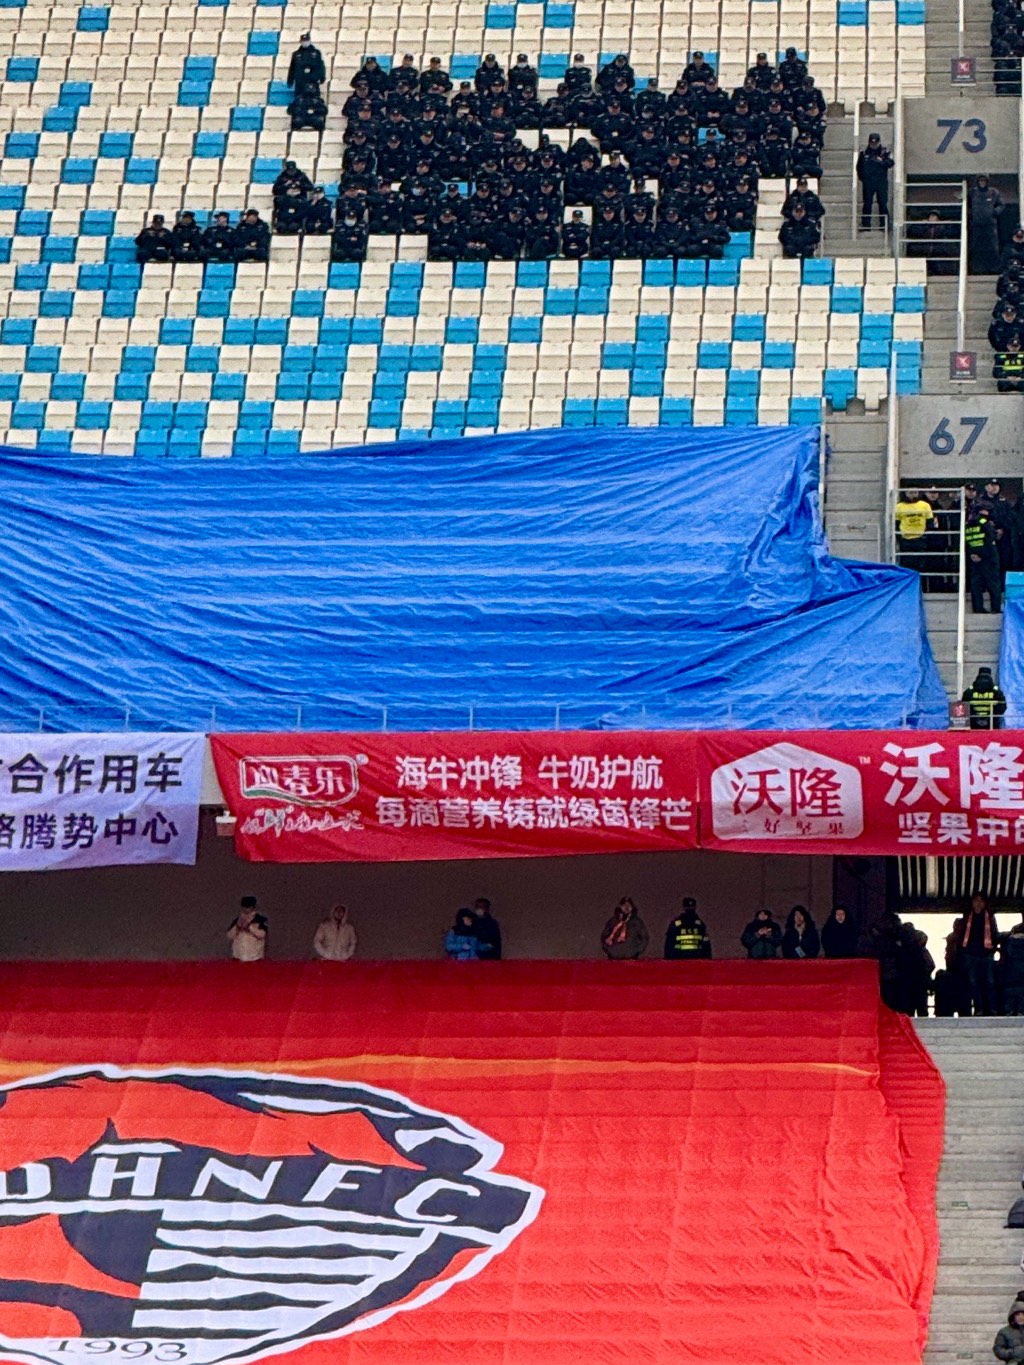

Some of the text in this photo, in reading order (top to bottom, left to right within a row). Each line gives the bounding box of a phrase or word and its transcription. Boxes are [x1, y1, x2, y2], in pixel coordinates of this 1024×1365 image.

[936, 118, 987, 153] 73
[929, 416, 988, 455] 67
[0, 752, 183, 794] 合作用车
[396, 755, 663, 790] 海牛冲锋 牛奶护航
[731, 767, 844, 817] 沃隆
[49, 1339, 188, 1362] 1993
